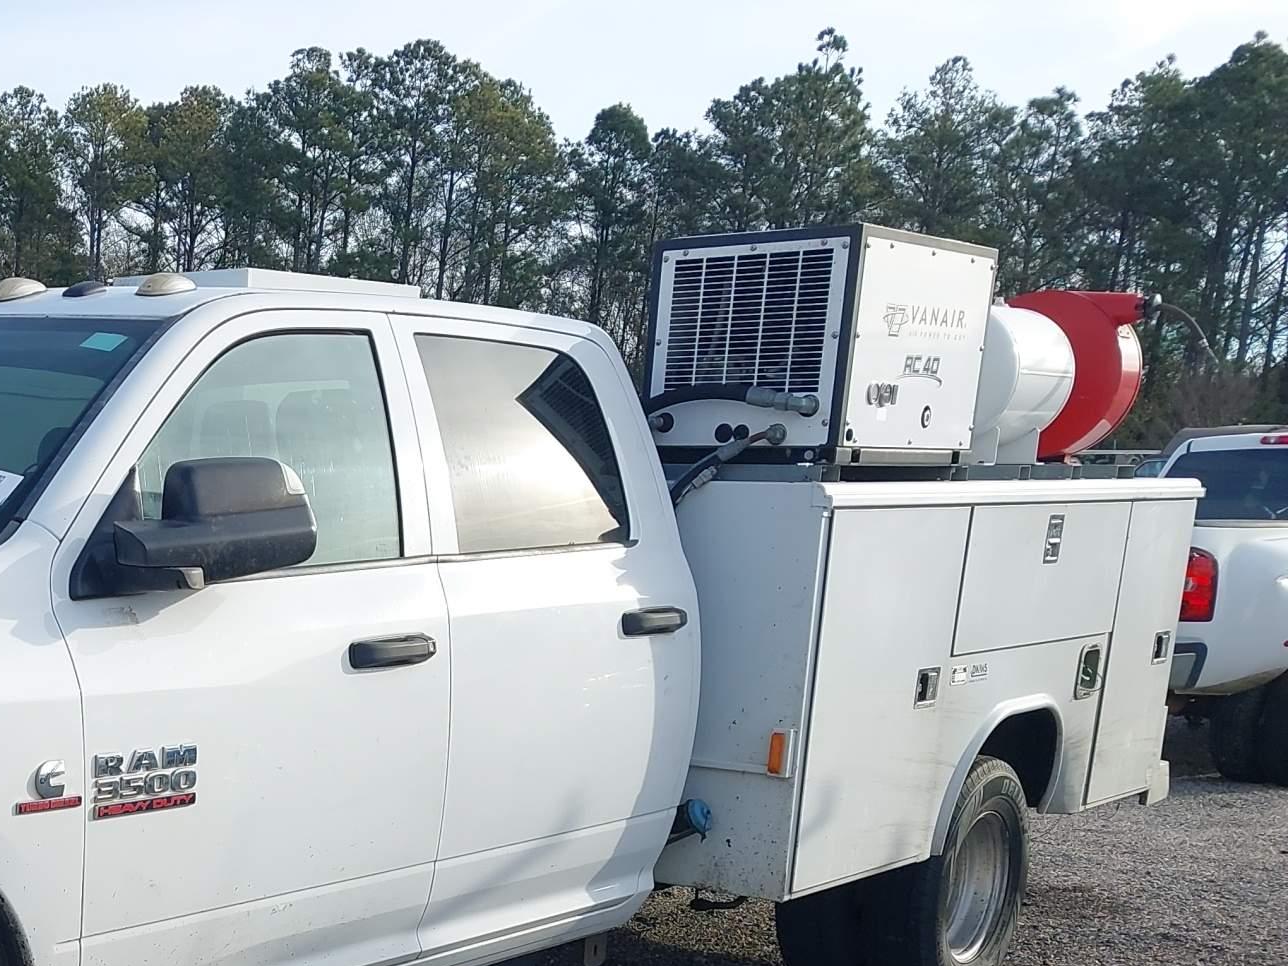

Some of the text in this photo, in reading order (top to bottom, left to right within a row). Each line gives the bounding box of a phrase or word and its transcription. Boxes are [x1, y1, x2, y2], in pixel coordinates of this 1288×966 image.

[912, 305, 965, 328] VANAIR
[91, 744, 197, 779] RAM
[92, 767, 197, 803] 3500
[99, 795, 193, 817] HEAVY DUTY
